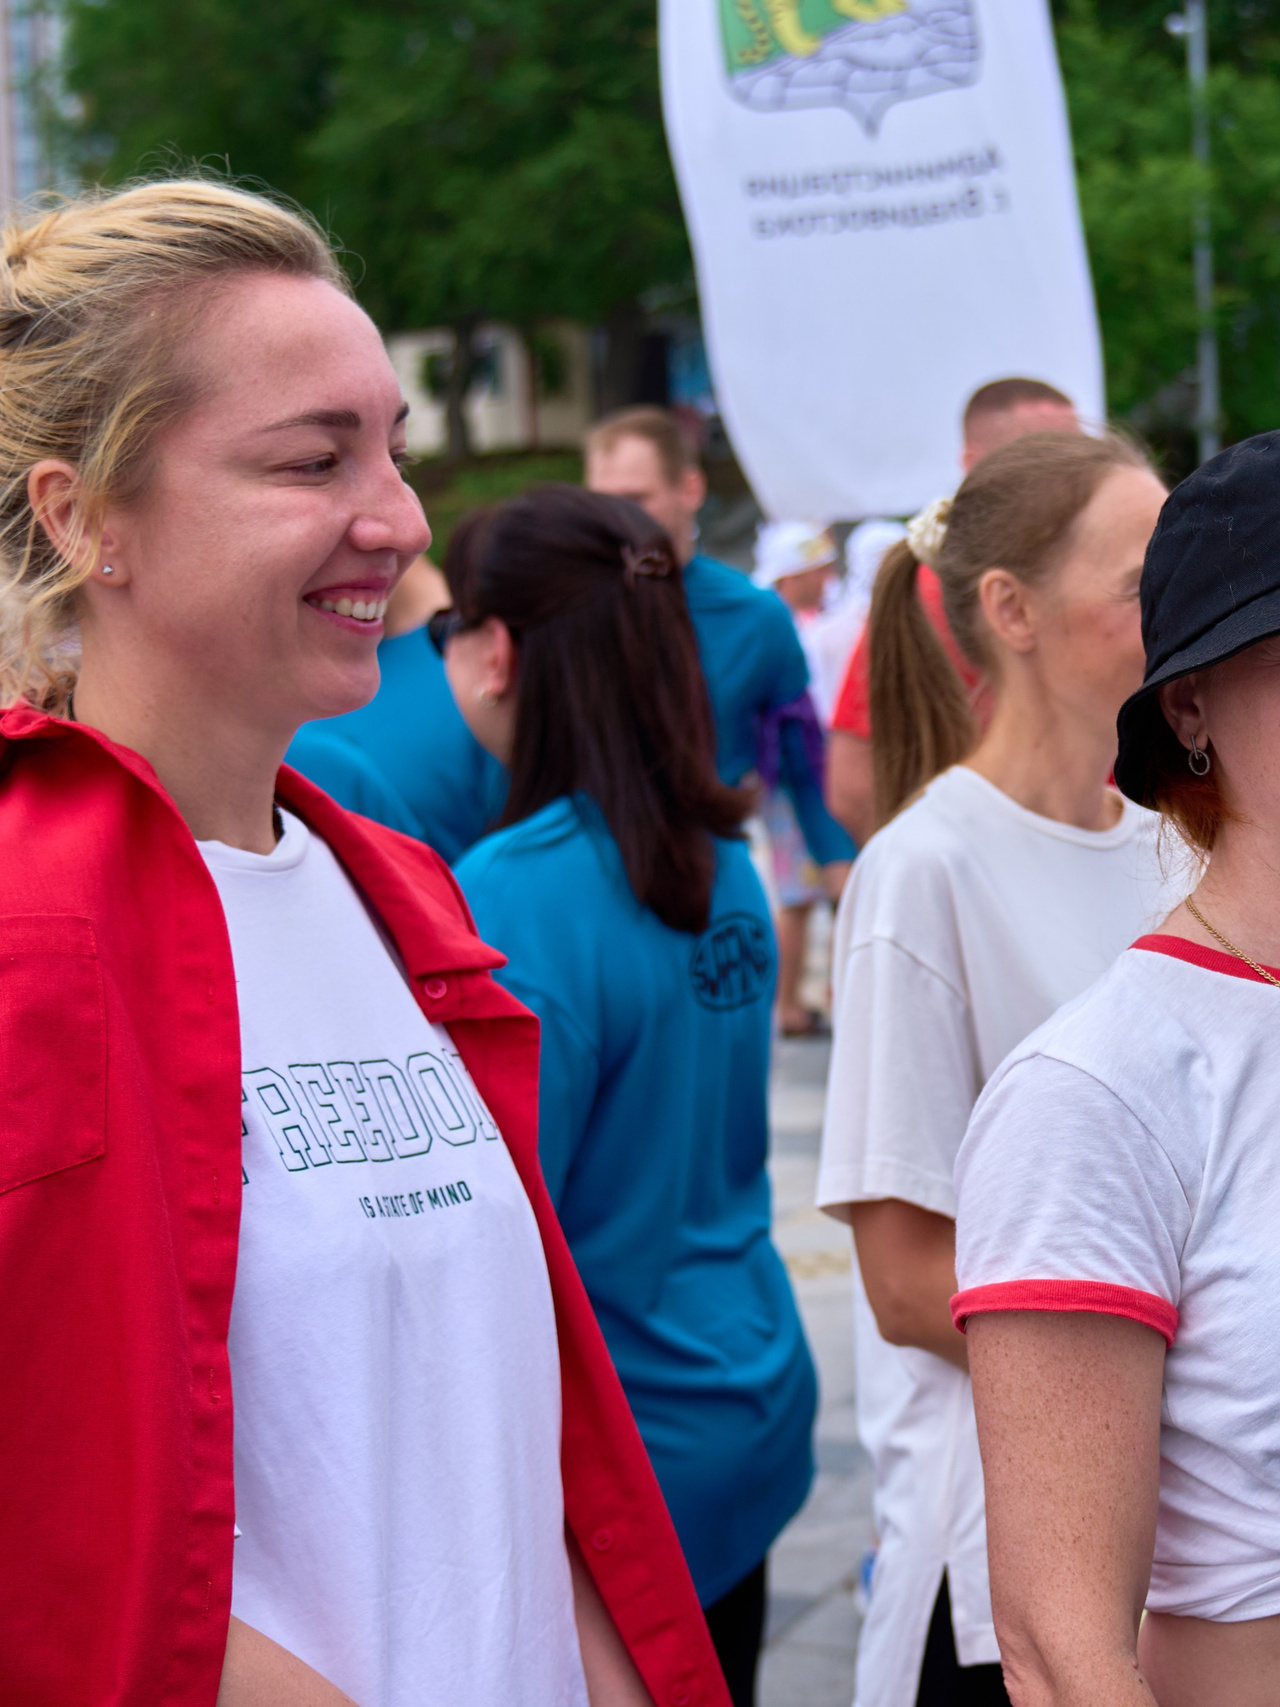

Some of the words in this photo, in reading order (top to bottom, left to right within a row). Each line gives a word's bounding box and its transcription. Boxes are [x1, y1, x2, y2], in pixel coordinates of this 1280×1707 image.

[242, 1048, 499, 1186] REEDO
[359, 1196, 376, 1218] IS
[375, 1195, 386, 1217] A
[408, 1191, 425, 1215] OF
[426, 1180, 473, 1210] MIND
